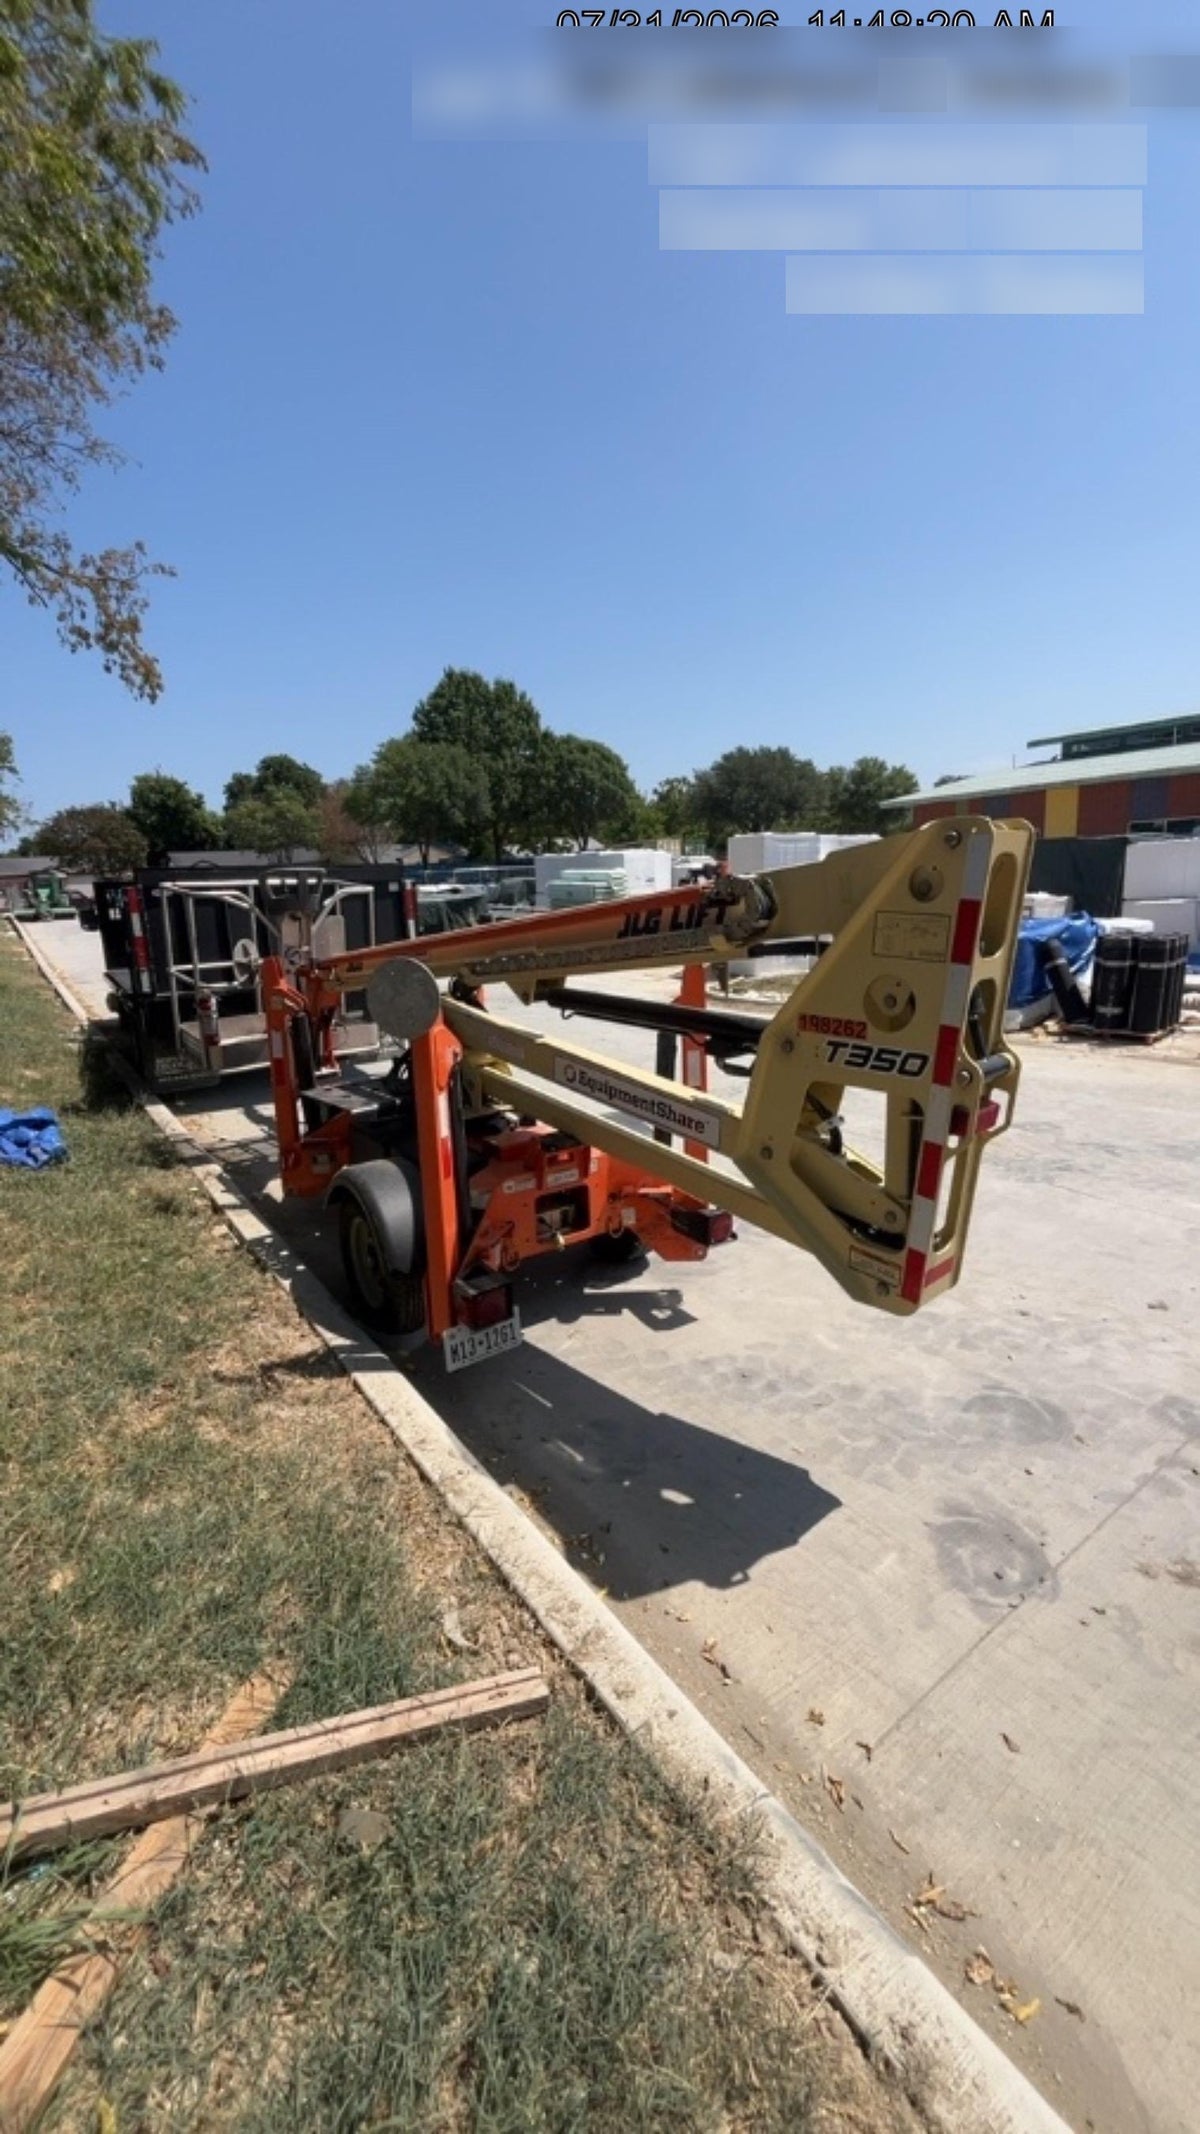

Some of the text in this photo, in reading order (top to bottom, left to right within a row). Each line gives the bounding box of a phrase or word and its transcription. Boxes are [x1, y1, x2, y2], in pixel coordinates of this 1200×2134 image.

[617, 909, 662, 938] JLG
[826, 1040, 929, 1077] T350
[579, 1067, 706, 1133] EquipmentShare
